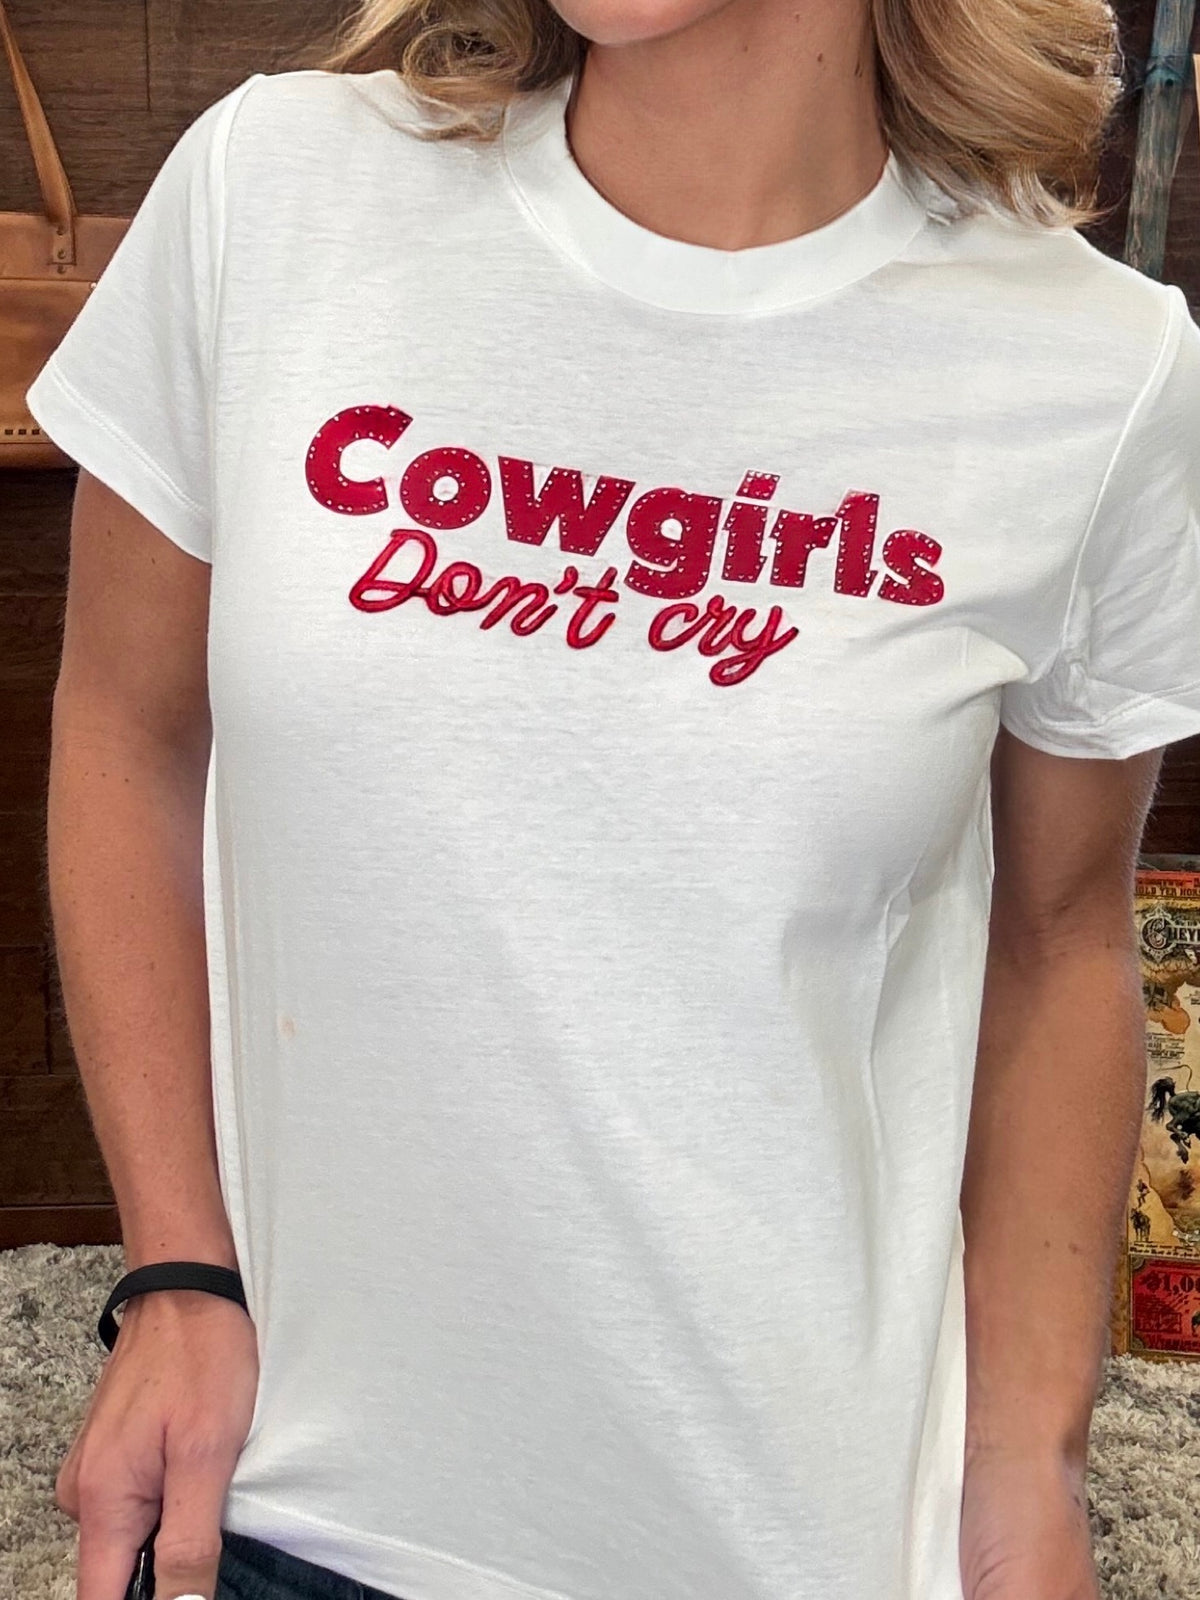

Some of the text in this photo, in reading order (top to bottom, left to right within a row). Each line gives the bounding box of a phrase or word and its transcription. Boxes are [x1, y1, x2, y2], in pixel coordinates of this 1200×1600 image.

[305, 403, 945, 607] Cowgirls
[349, 528, 798, 688] Don't cry
